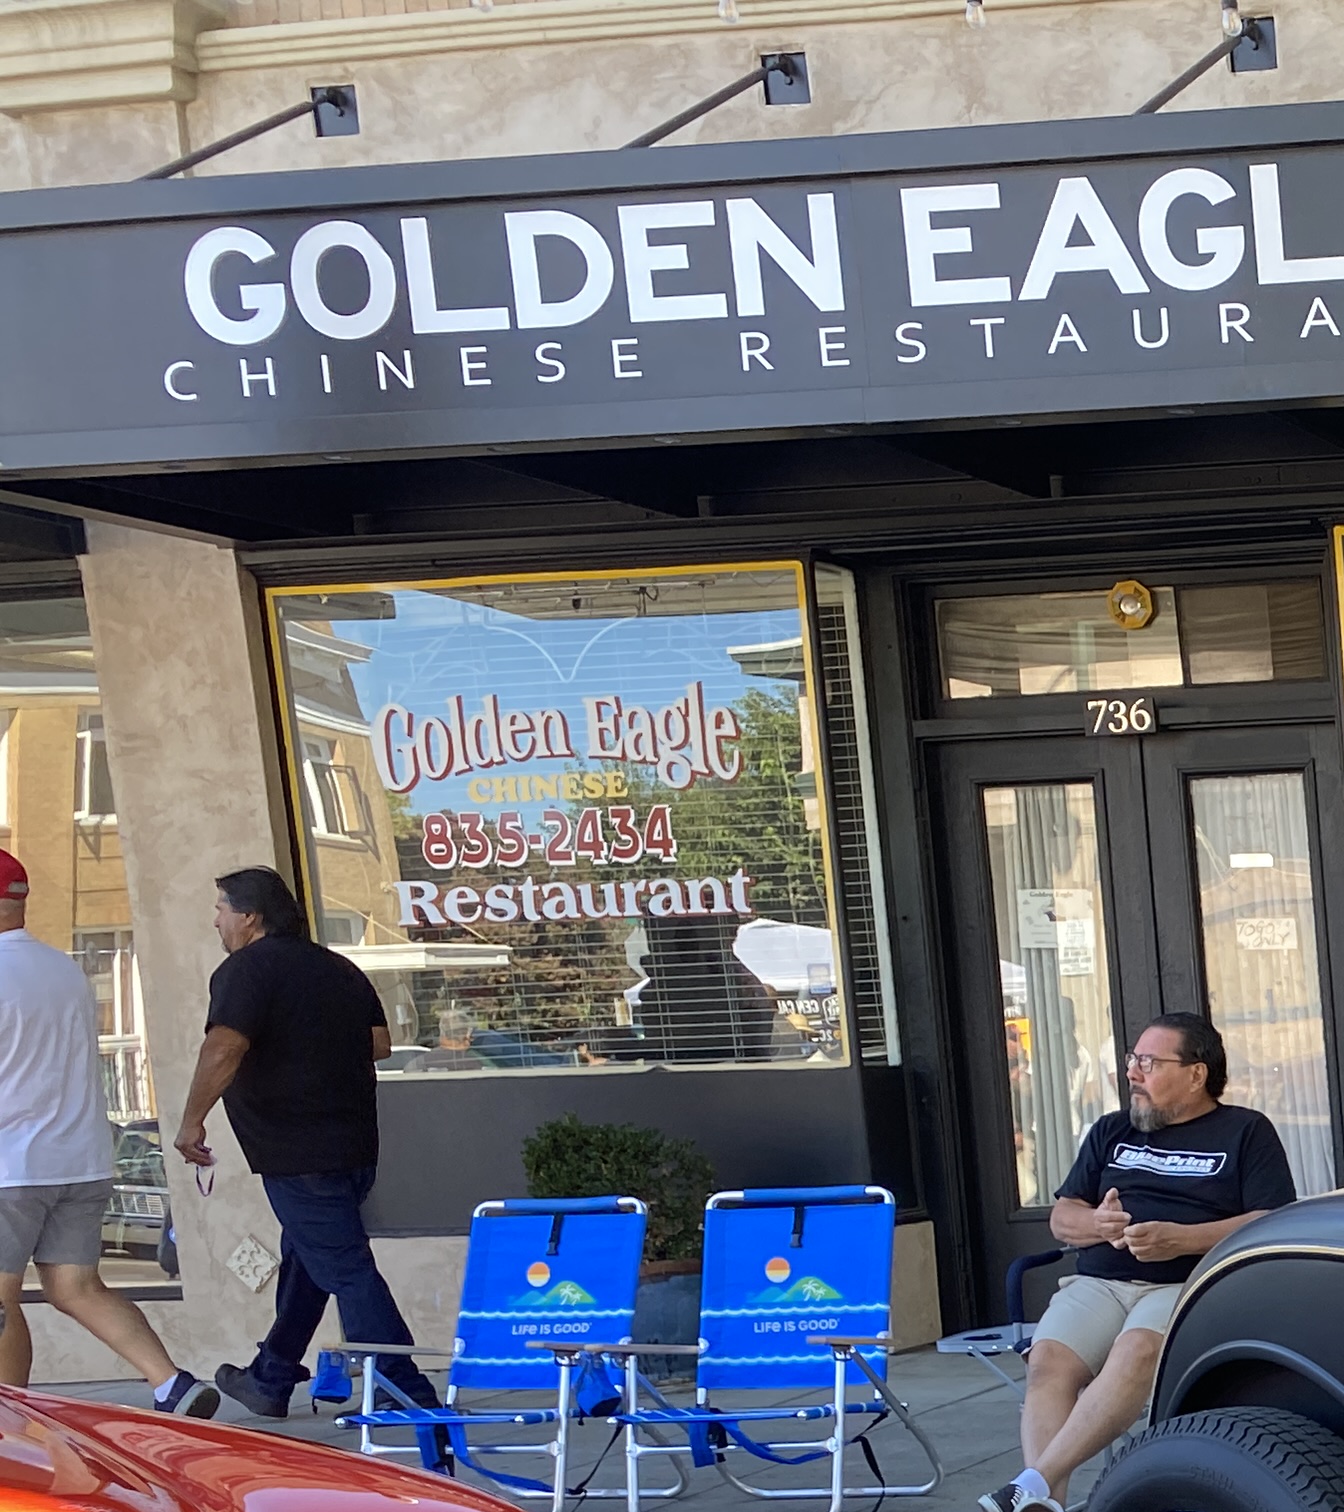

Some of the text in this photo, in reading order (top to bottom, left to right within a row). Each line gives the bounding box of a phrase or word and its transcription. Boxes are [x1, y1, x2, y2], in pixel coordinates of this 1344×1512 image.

[184, 192, 845, 346] GOLDEN
[163, 337, 644, 401] CHINESE
[371, 680, 743, 794] Golden Eagle
[1087, 698, 1152, 733] 736
[466, 770, 629, 804] CHINESE
[421, 803, 678, 870] 835-2434
[393, 868, 753, 928] Restaurant
[539, 1323, 551, 1335] IS
[553, 1322, 591, 1335] GOOD
[783, 1320, 796, 1333] IS
[797, 1318, 839, 1332] GOOD
